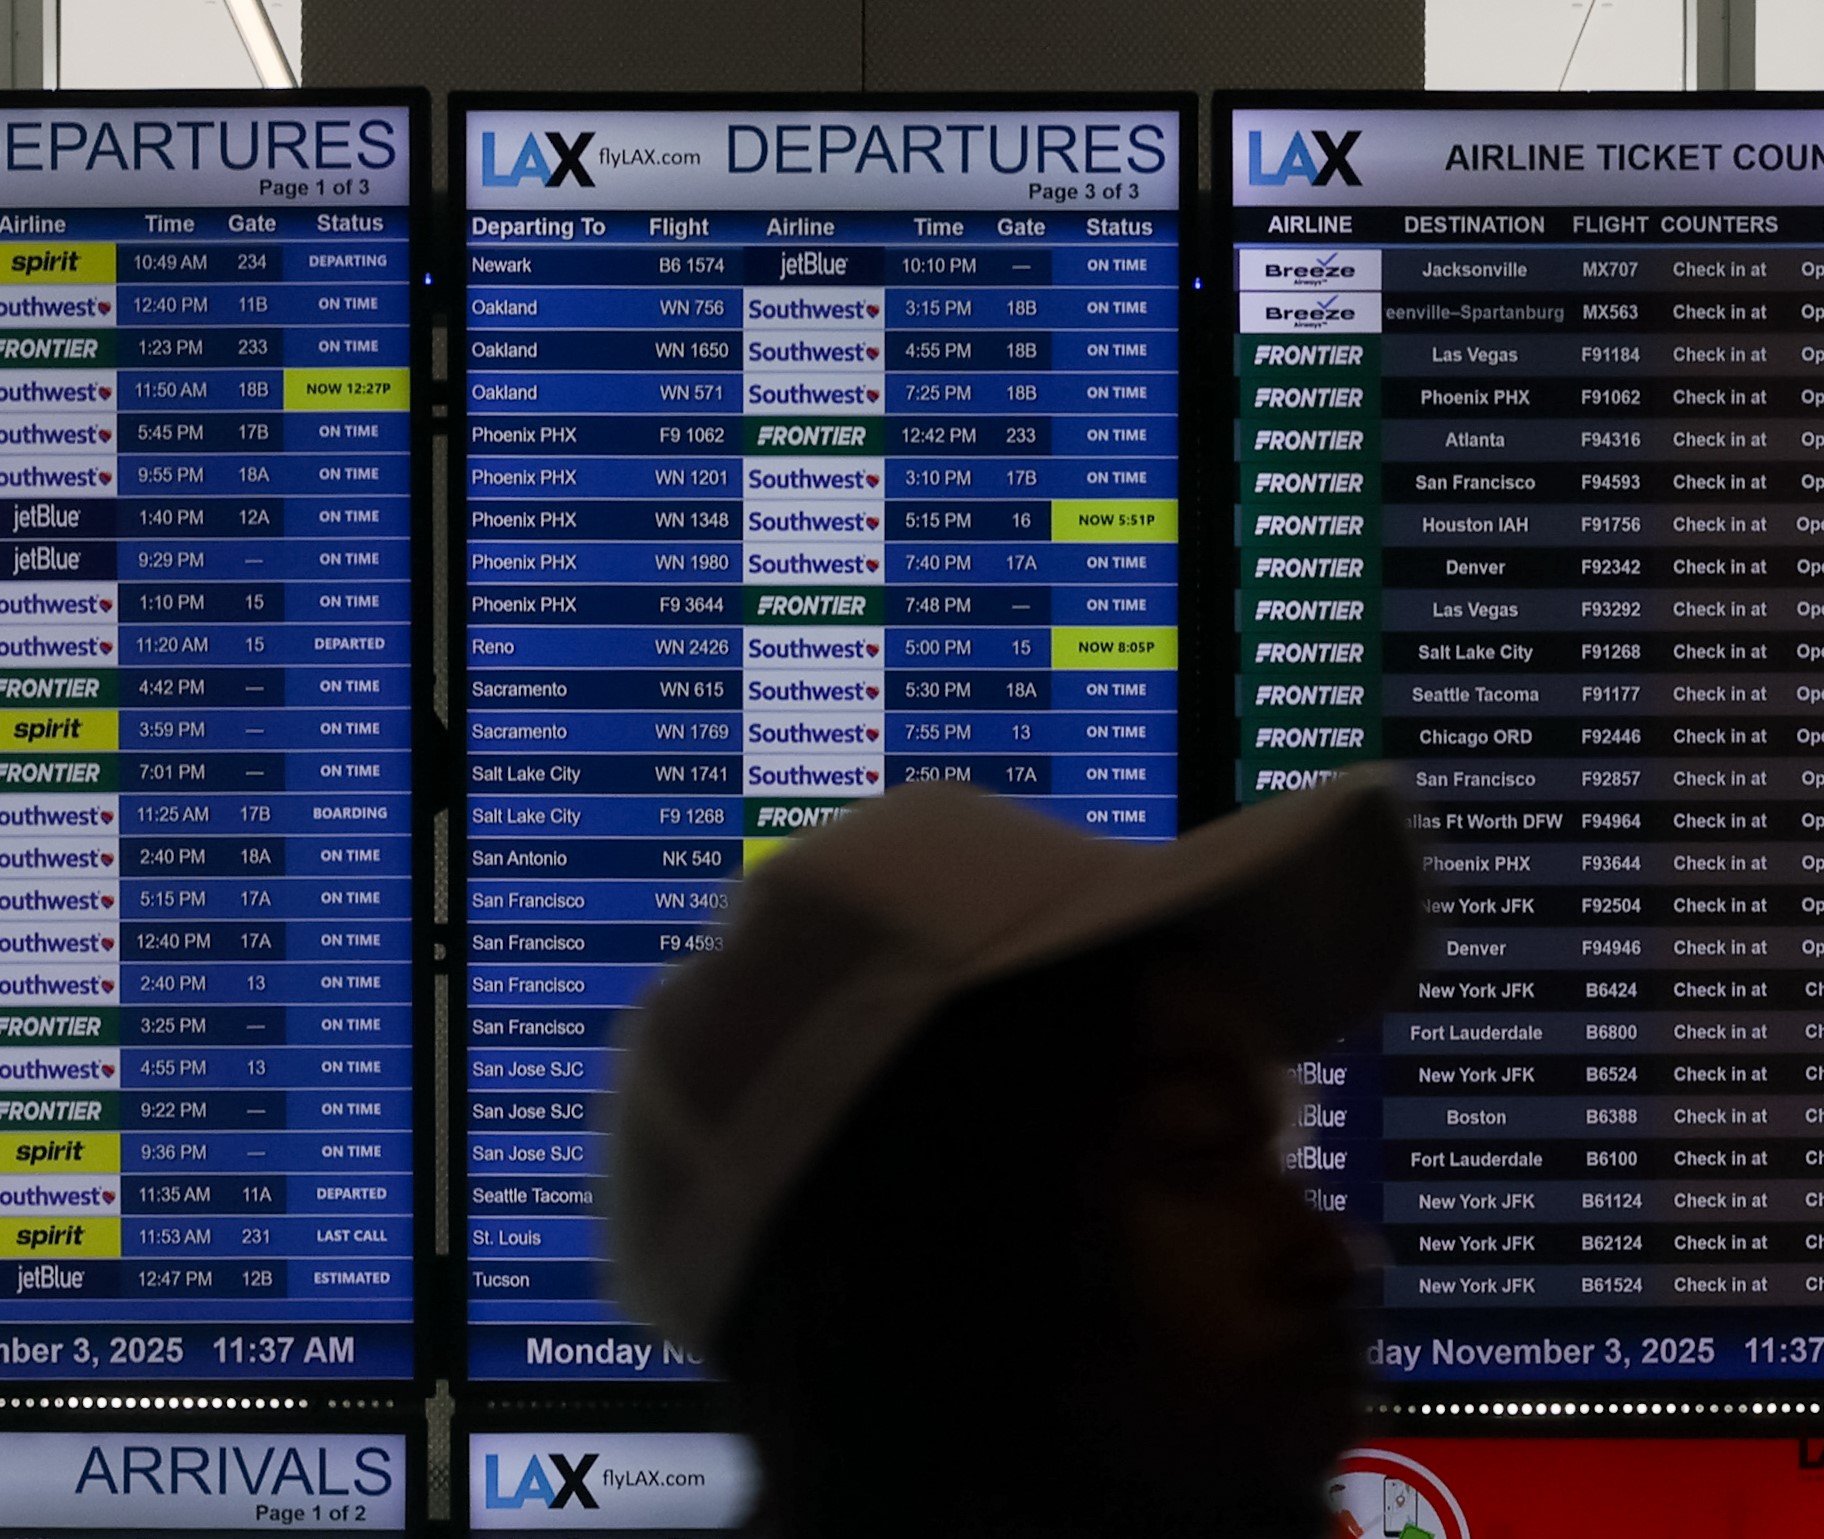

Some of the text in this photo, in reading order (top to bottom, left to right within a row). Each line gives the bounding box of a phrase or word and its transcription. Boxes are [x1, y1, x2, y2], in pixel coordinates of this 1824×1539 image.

[600, 148, 700, 168] flyLAX.com
[729, 124, 1165, 174] DEPARTURES
[1248, 130, 1363, 186] LAX
[1446, 145, 1584, 171] AIRLINE
[1597, 144, 1722, 170] TICKET
[482, 132, 596, 188] LAX
[260, 179, 369, 199] Page 1 of 3
[1030, 183, 1139, 203] Page 3 of 3
[145, 215, 194, 232] Time
[229, 215, 276, 231] Gate
[318, 215, 383, 231] Status
[473, 218, 1152, 240] Departing To Flight Airline Time Gate Status
[1268, 216, 1352, 233] AIRLINE
[1405, 216, 1544, 233] DESTINATION
[1573, 216, 1649, 233] FLIGHT
[1661, 216, 1778, 233] COUNTERS
[12, 251, 79, 275] spirit
[135, 255, 177, 270] 10:49
[181, 255, 207, 269] AM
[238, 254, 266, 269] 234
[310, 255, 387, 267] DEPARTING
[1265, 263, 1355, 279] Breeze
[1423, 262, 1527, 277] Jacksonville
[1583, 262, 1638, 276] MX707
[1673, 262, 1725, 276] Check
[1731, 262, 1745, 276] in
[1751, 262, 1766, 276] at
[472, 341, 1146, 361] Oakland WN 1650 Southwest 4:55 PM 18B ON TIME
[136, 382, 176, 397] 11:50
[180, 382, 206, 397] AM
[240, 382, 268, 397] 18B
[307, 384, 342, 394] NOW
[348, 383, 390, 394] 12:27P
[1255, 474, 1364, 493] FRONTIER
[74, 1338, 98, 1368] 3,
[110, 1337, 183, 1363] 2025
[214, 1337, 294, 1363] 11:37
[304, 1337, 353, 1363] AM
[528, 1338, 651, 1370] Monday
[1433, 1339, 1595, 1364] November
[1605, 1338, 1630, 1368] 3,
[1642, 1338, 1714, 1363] 2025
[1745, 1337, 1824, 1362] 11:37
[75, 1446, 391, 1496] ARRIVALS
[485, 1453, 599, 1510] LAX
[604, 1470, 704, 1489] flyLAX.com
[257, 1505, 365, 1524] Page 1 of 2
